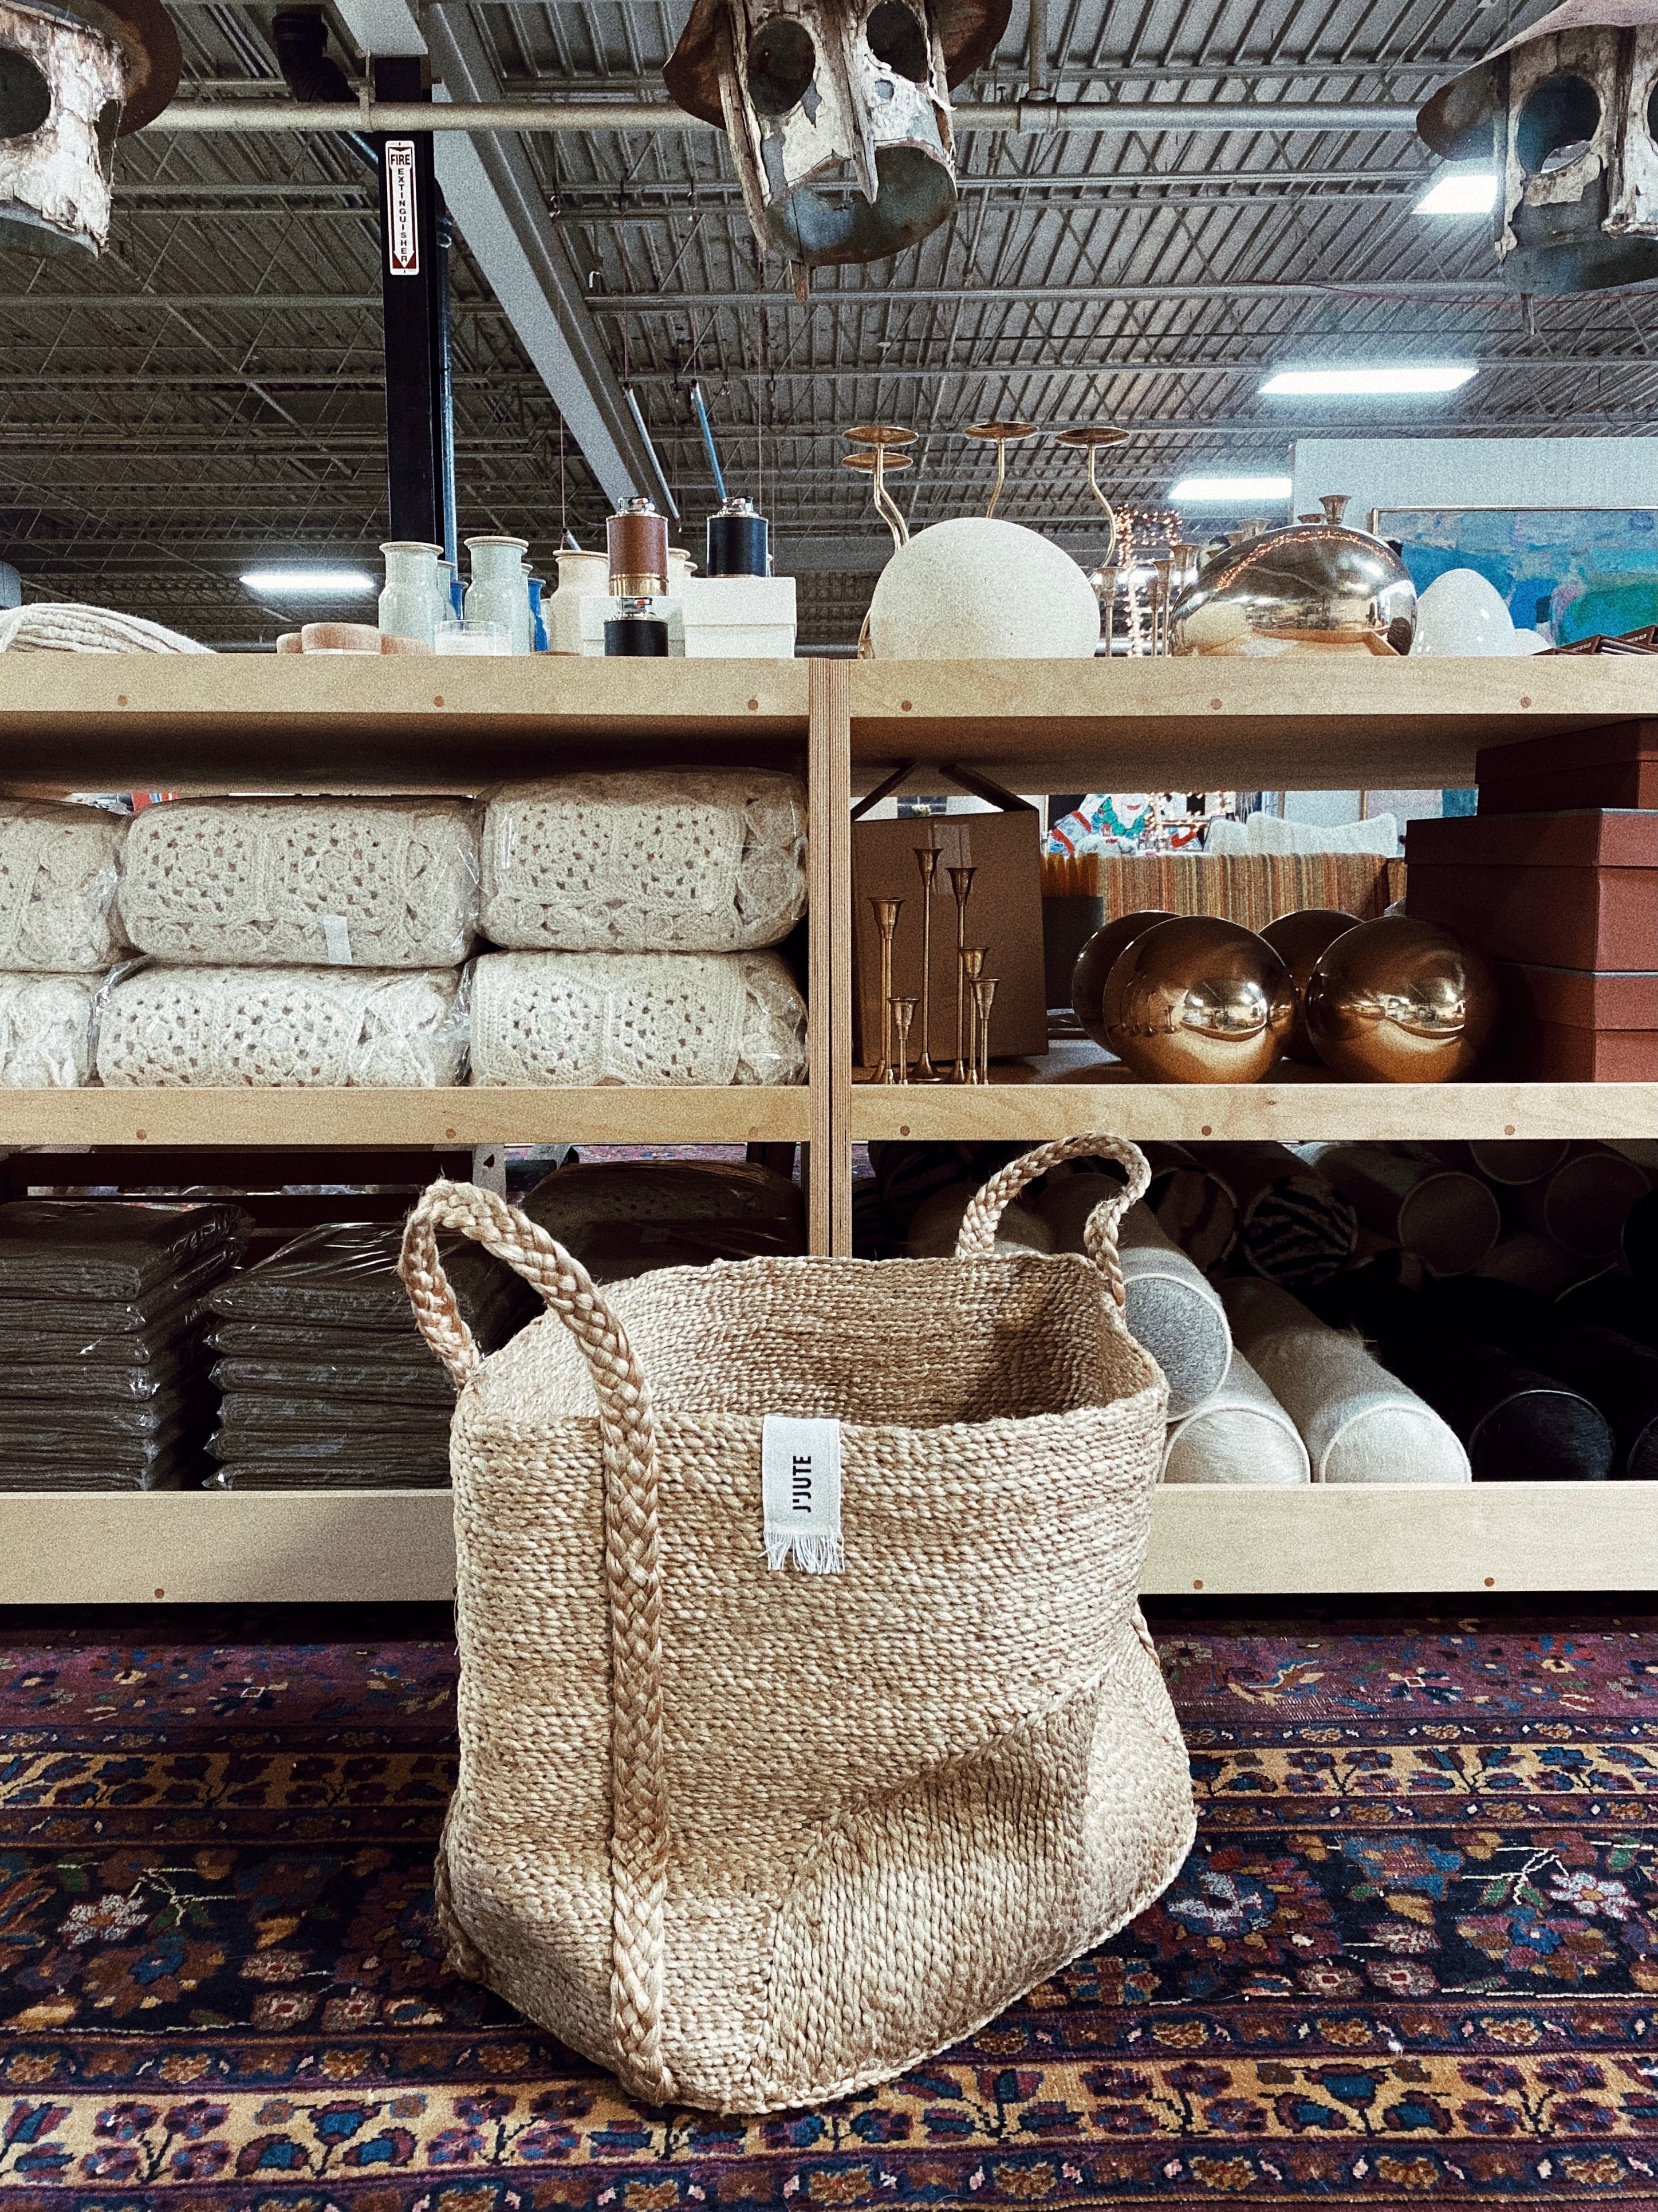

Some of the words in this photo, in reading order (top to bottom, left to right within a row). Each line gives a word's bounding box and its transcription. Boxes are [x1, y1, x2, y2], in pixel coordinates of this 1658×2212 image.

[391, 154, 411, 165] FIRE
[398, 168, 407, 262] EXTINGUISHER
[792, 1456, 812, 1513] J'JUTE
